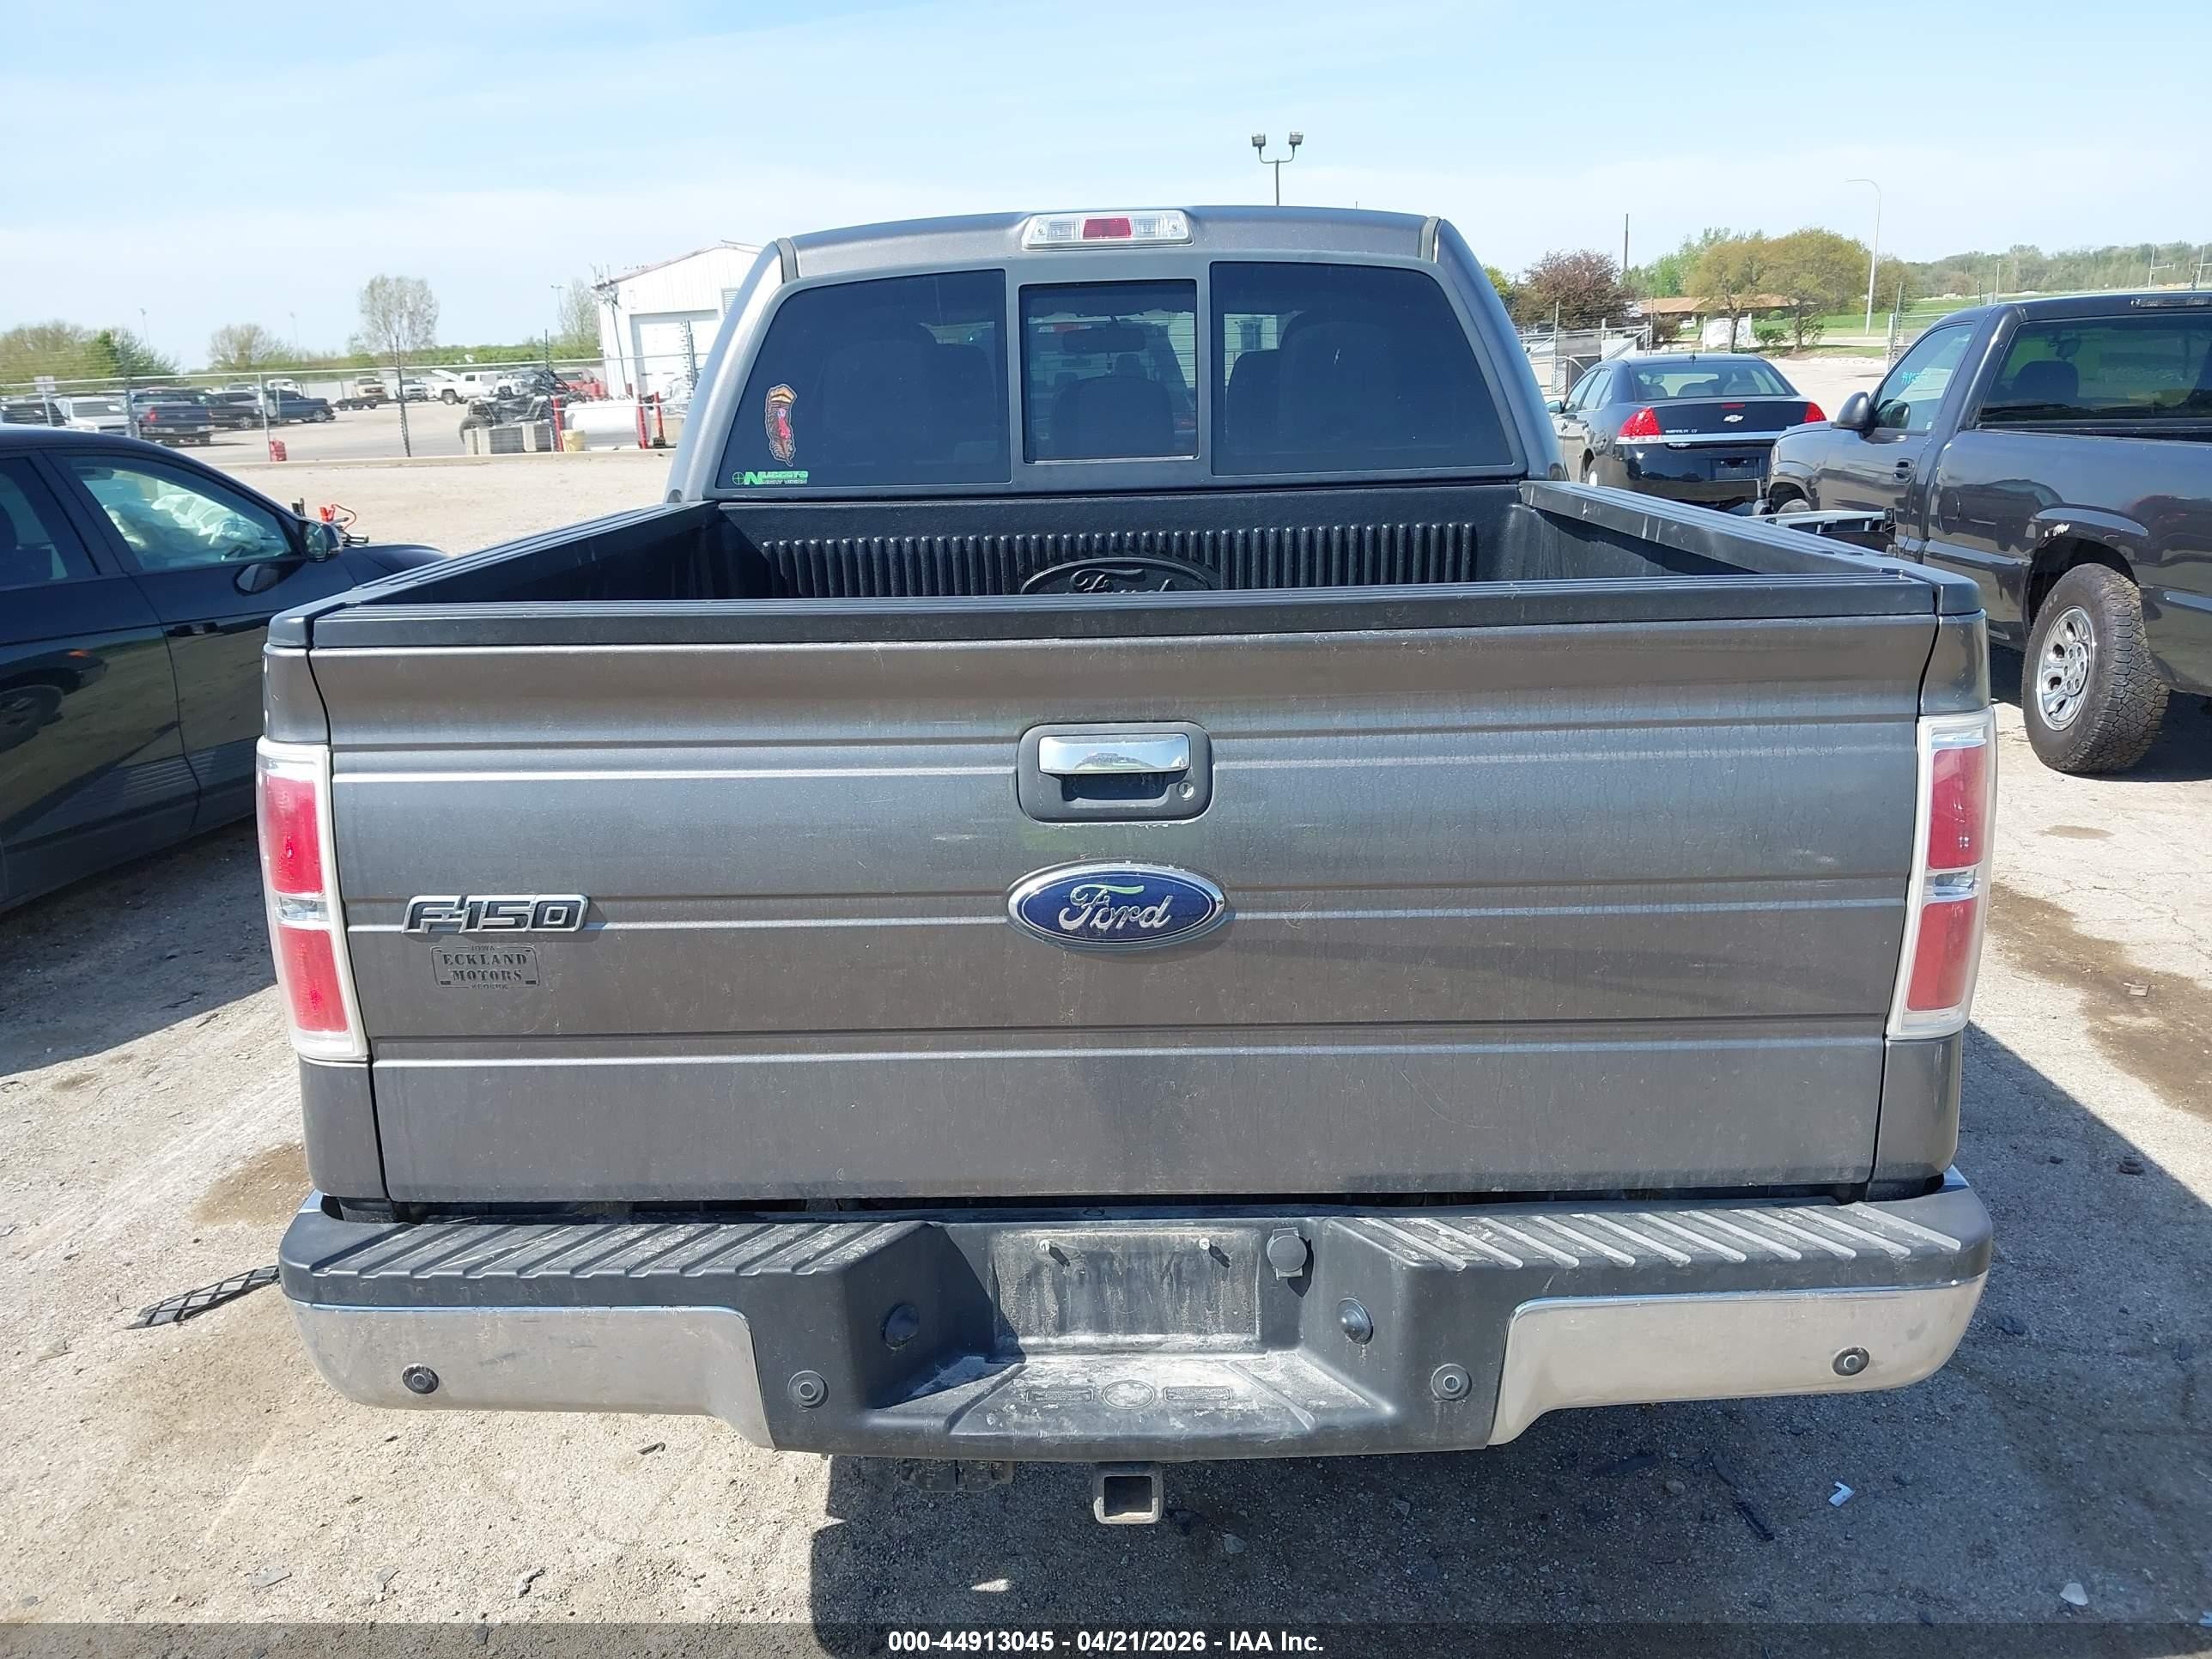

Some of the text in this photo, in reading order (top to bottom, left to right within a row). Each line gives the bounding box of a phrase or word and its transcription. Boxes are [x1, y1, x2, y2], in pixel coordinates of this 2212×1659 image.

[401, 894, 589, 934] F-150
[1058, 884, 1174, 930] Ford
[442, 953, 527, 965] ECKLAND
[453, 969, 522, 981] MOTORS
